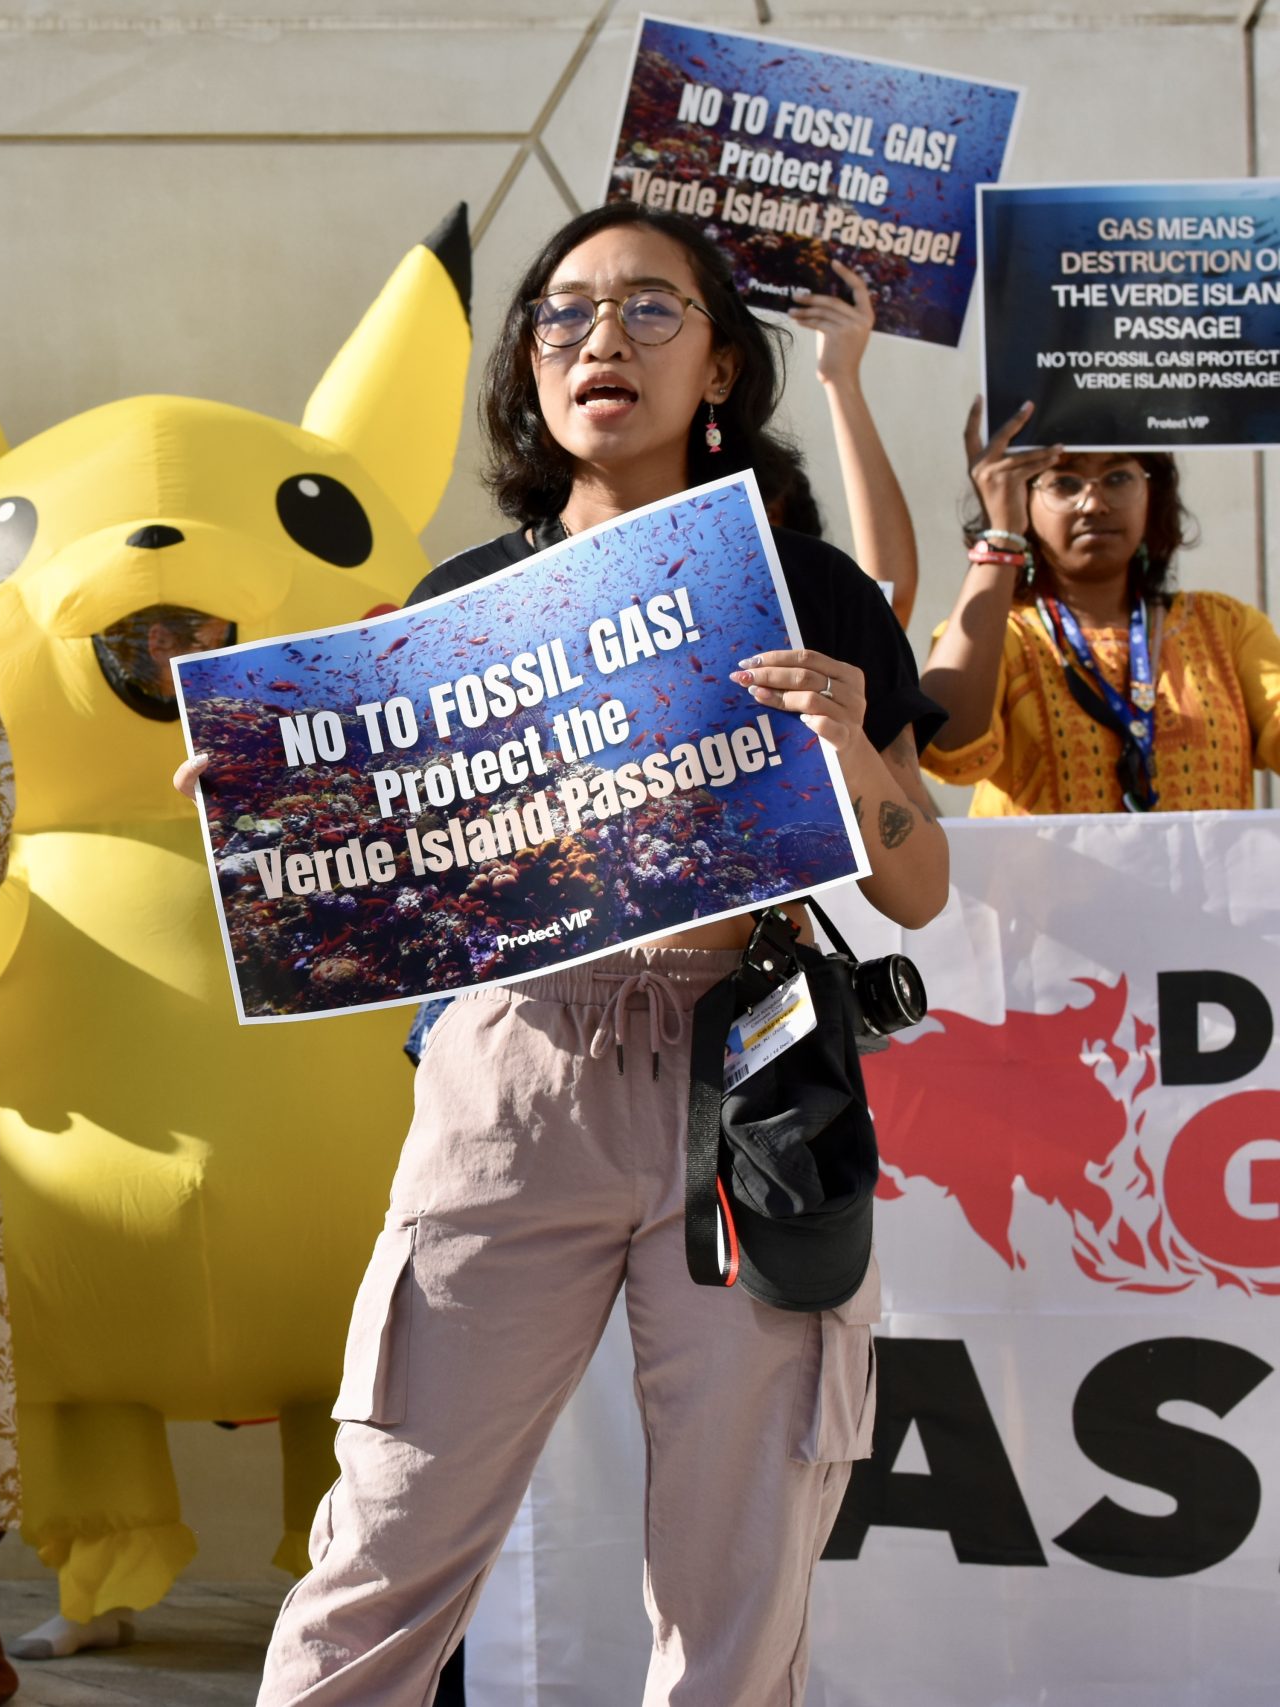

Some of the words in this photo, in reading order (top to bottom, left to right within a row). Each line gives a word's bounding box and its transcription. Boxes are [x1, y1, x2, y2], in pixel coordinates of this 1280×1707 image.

[677, 83, 723, 127] NO
[730, 92, 769, 135] TO
[773, 101, 875, 157] FOSSIL
[883, 123, 957, 173] GAS!
[719, 141, 833, 195] Protect
[839, 164, 889, 206] the
[631, 170, 718, 218] Verde
[722, 188, 817, 237] Island
[822, 204, 961, 266] Passage!
[1098, 217, 1153, 241] GAS
[1157, 215, 1255, 240] MEANS
[748, 277, 789, 297] Protect
[1060, 249, 1252, 275] DESTRUCTION
[1255, 248, 1280, 272] O
[1052, 284, 1108, 307] THE
[1111, 283, 1199, 306] VERDE
[1203, 282, 1280, 306] ISLAN
[1114, 316, 1241, 339] PASSAGE!
[1037, 352, 1066, 368] NO
[1067, 352, 1093, 368] TO
[1094, 351, 1154, 367] FOSSIL
[1155, 350, 1195, 367] GAS!
[1197, 350, 1280, 367] PROTECT
[1074, 373, 1132, 389] VERDE
[1134, 372, 1197, 388] ISLAND
[1198, 371, 1280, 388] PASSAGE
[1147, 417, 1188, 429] Protect
[1189, 416, 1210, 428] VIP
[278, 711, 347, 767] NO
[356, 696, 420, 754] TO
[428, 638, 584, 740] FOSSIL
[588, 587, 701, 676] GAS!
[372, 722, 549, 820] Protect
[552, 699, 630, 765] the
[253, 837, 397, 900] Verde
[405, 791, 556, 877] Island
[556, 714, 783, 833] Passage!
[496, 921, 563, 952] Protect
[560, 908, 594, 942] VIP
[1156, 970, 1274, 1087] D
[1162, 1089, 1280, 1268] G
[819, 1335, 1280, 1579] AS
